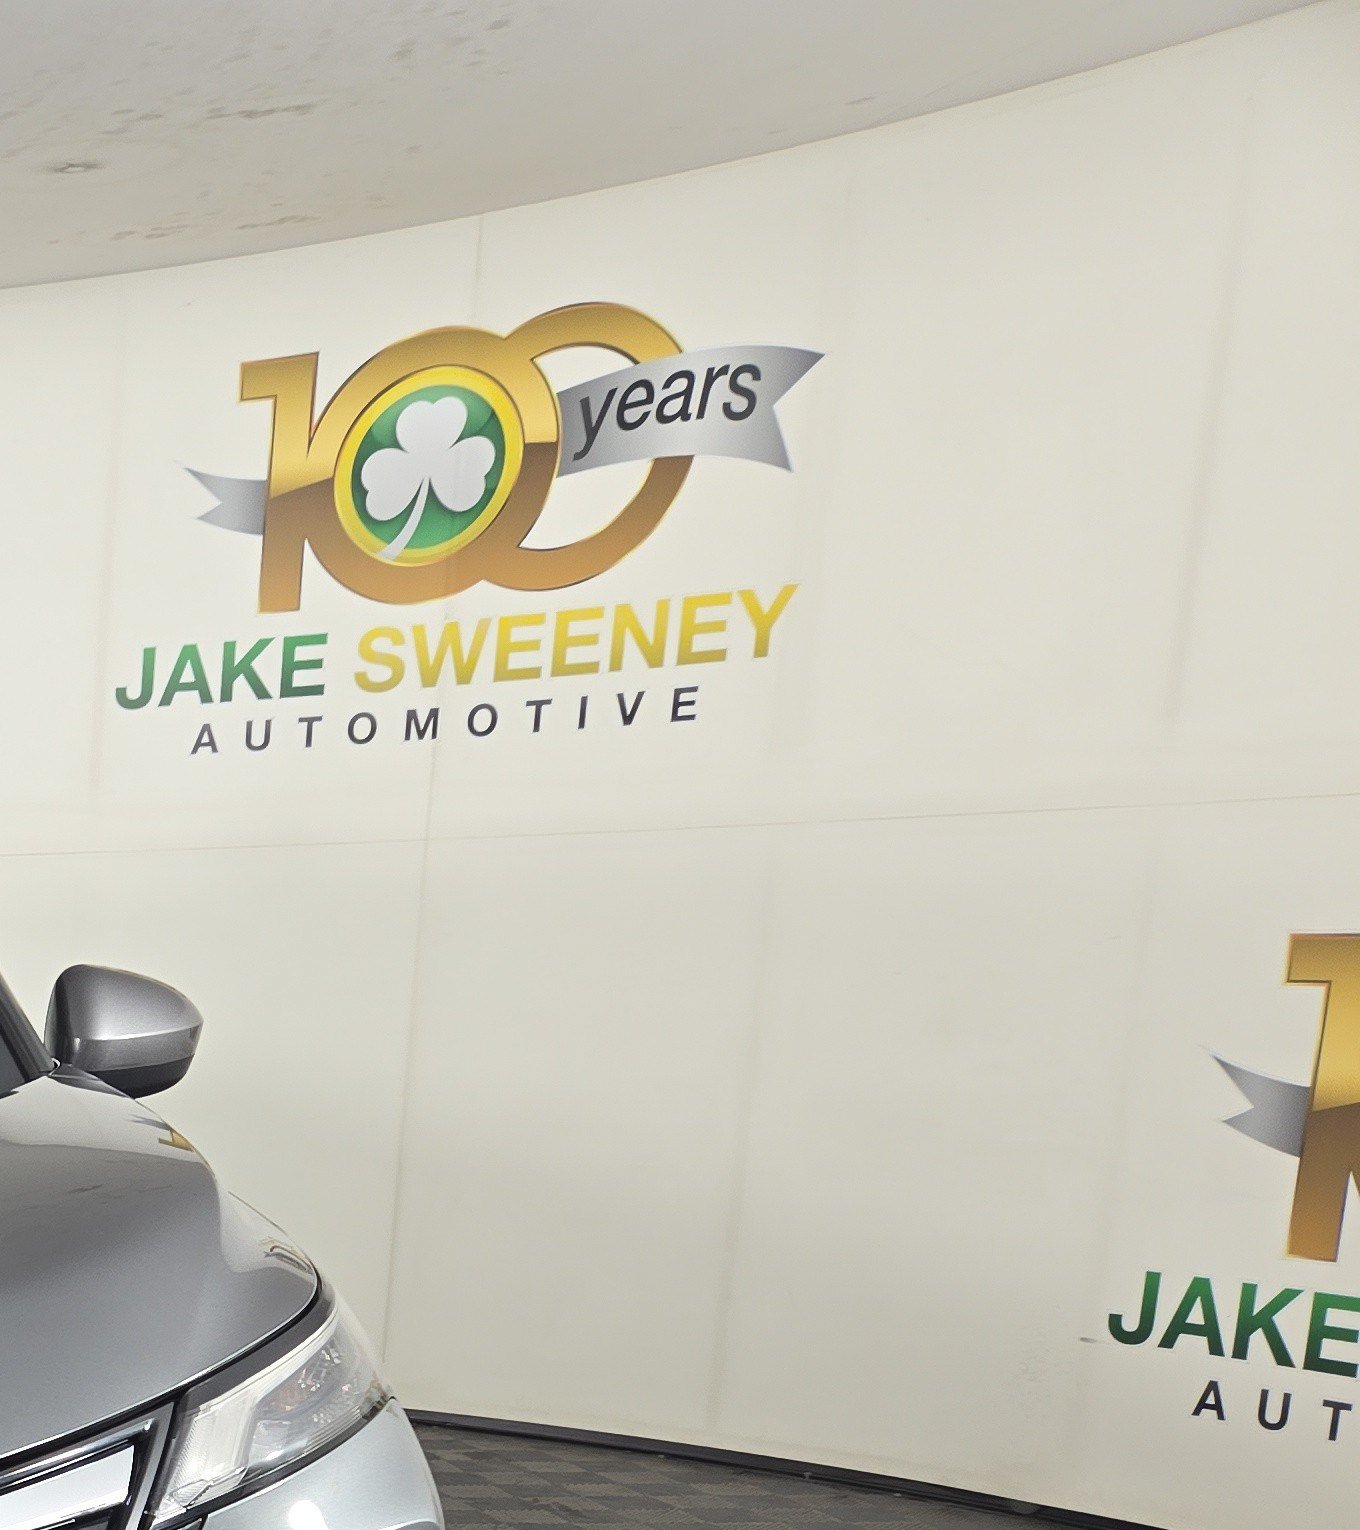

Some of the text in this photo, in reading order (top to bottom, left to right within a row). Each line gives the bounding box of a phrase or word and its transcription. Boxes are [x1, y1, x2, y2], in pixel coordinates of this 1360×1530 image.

[239, 302, 762, 614] 100 years
[114, 584, 800, 711] JAKE SWEENEY
[190, 686, 699, 756] AUTOMOTIVE
[1107, 1270, 1360, 1379] JAKE
